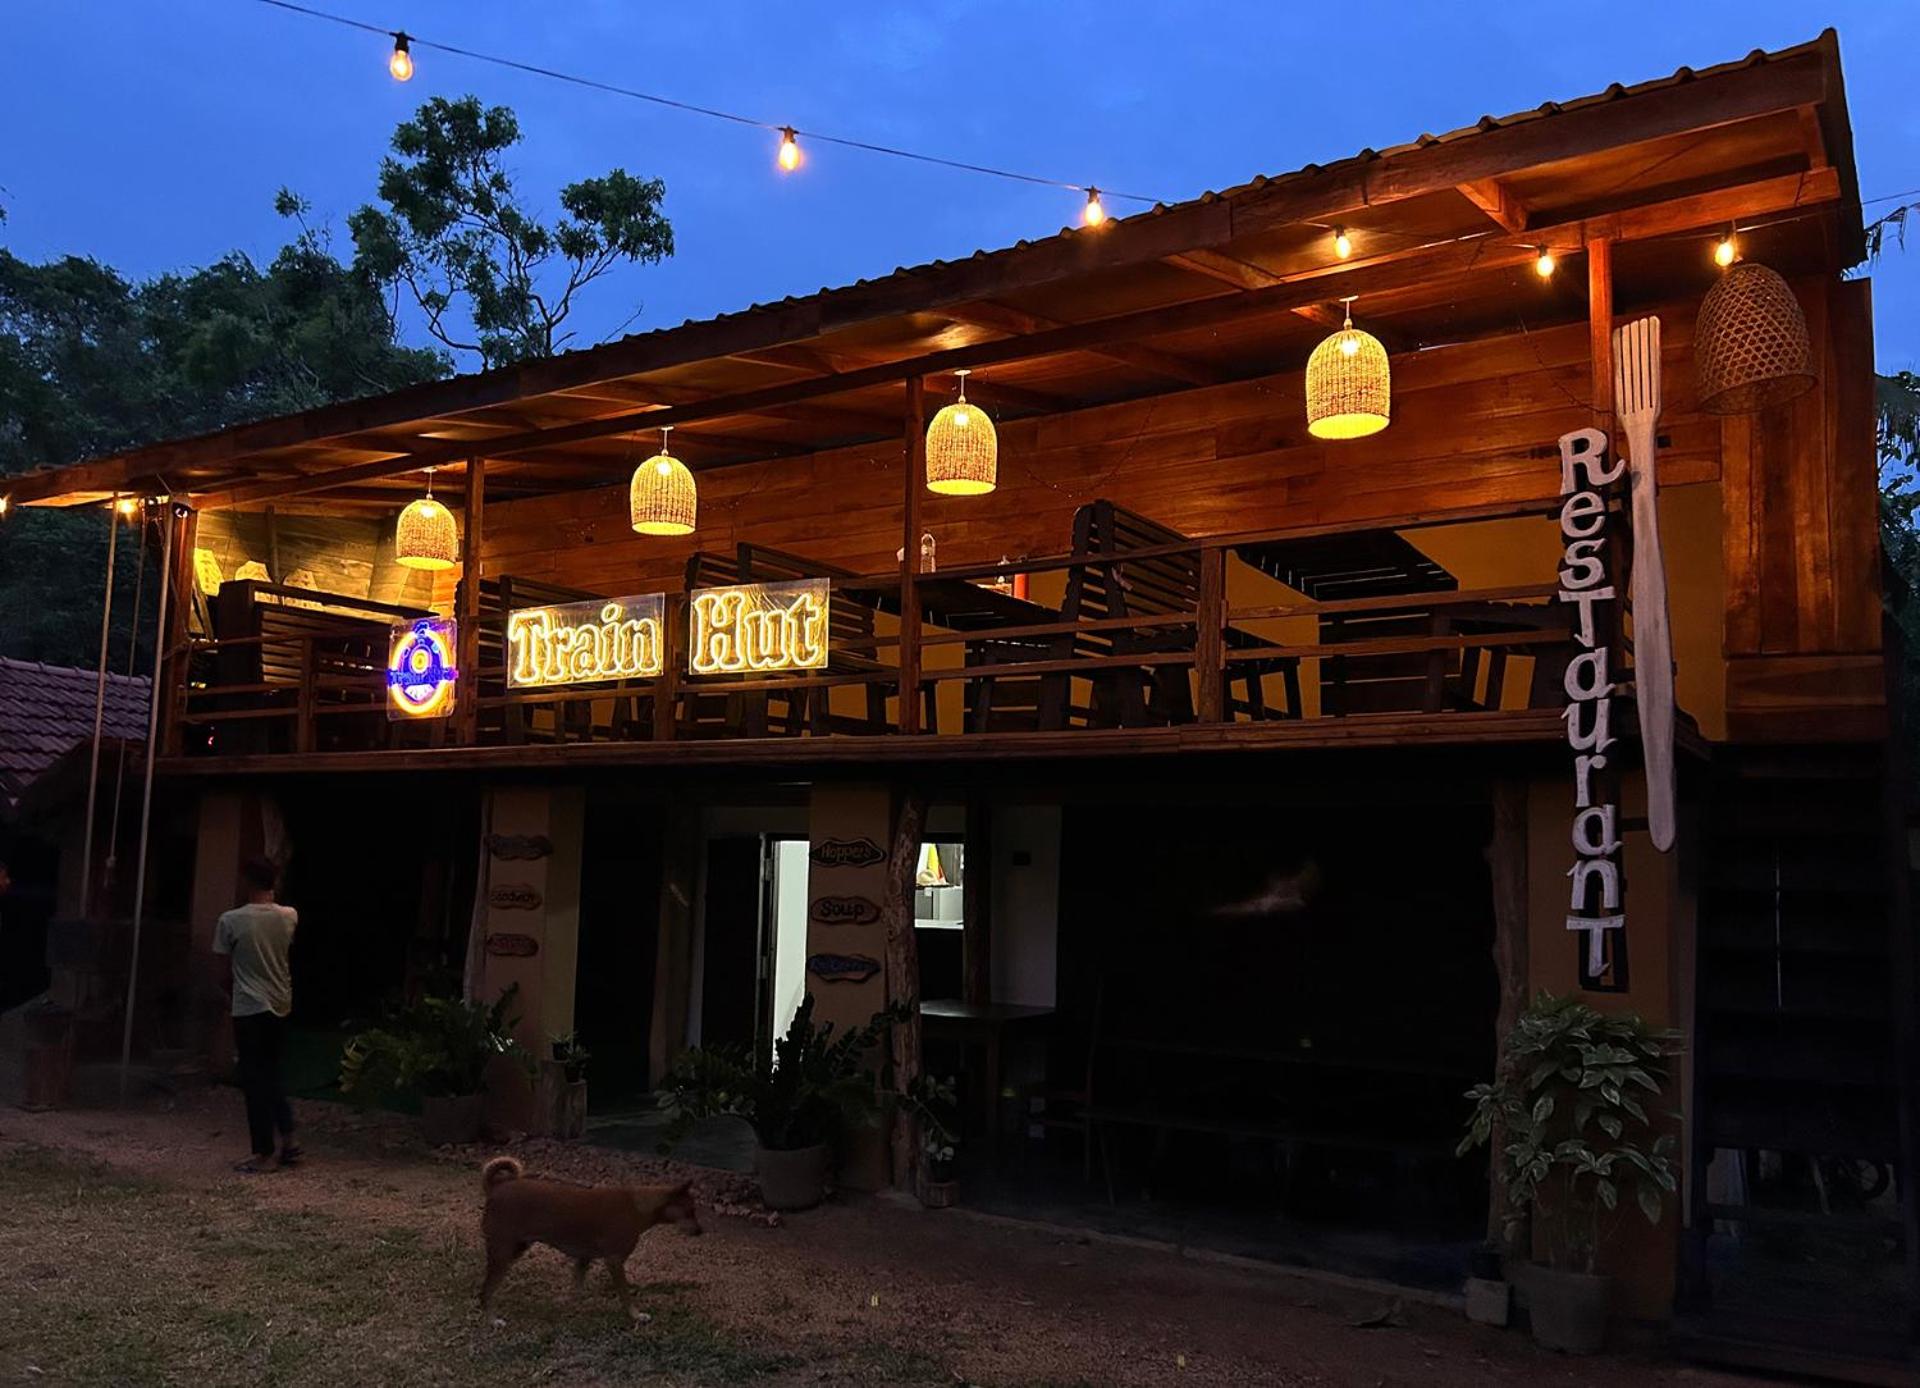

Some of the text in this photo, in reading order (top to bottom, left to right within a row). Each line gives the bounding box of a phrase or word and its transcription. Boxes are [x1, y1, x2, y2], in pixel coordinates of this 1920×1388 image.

[511, 590, 821, 684] Train Hut
[820, 900, 866, 919] Soup
